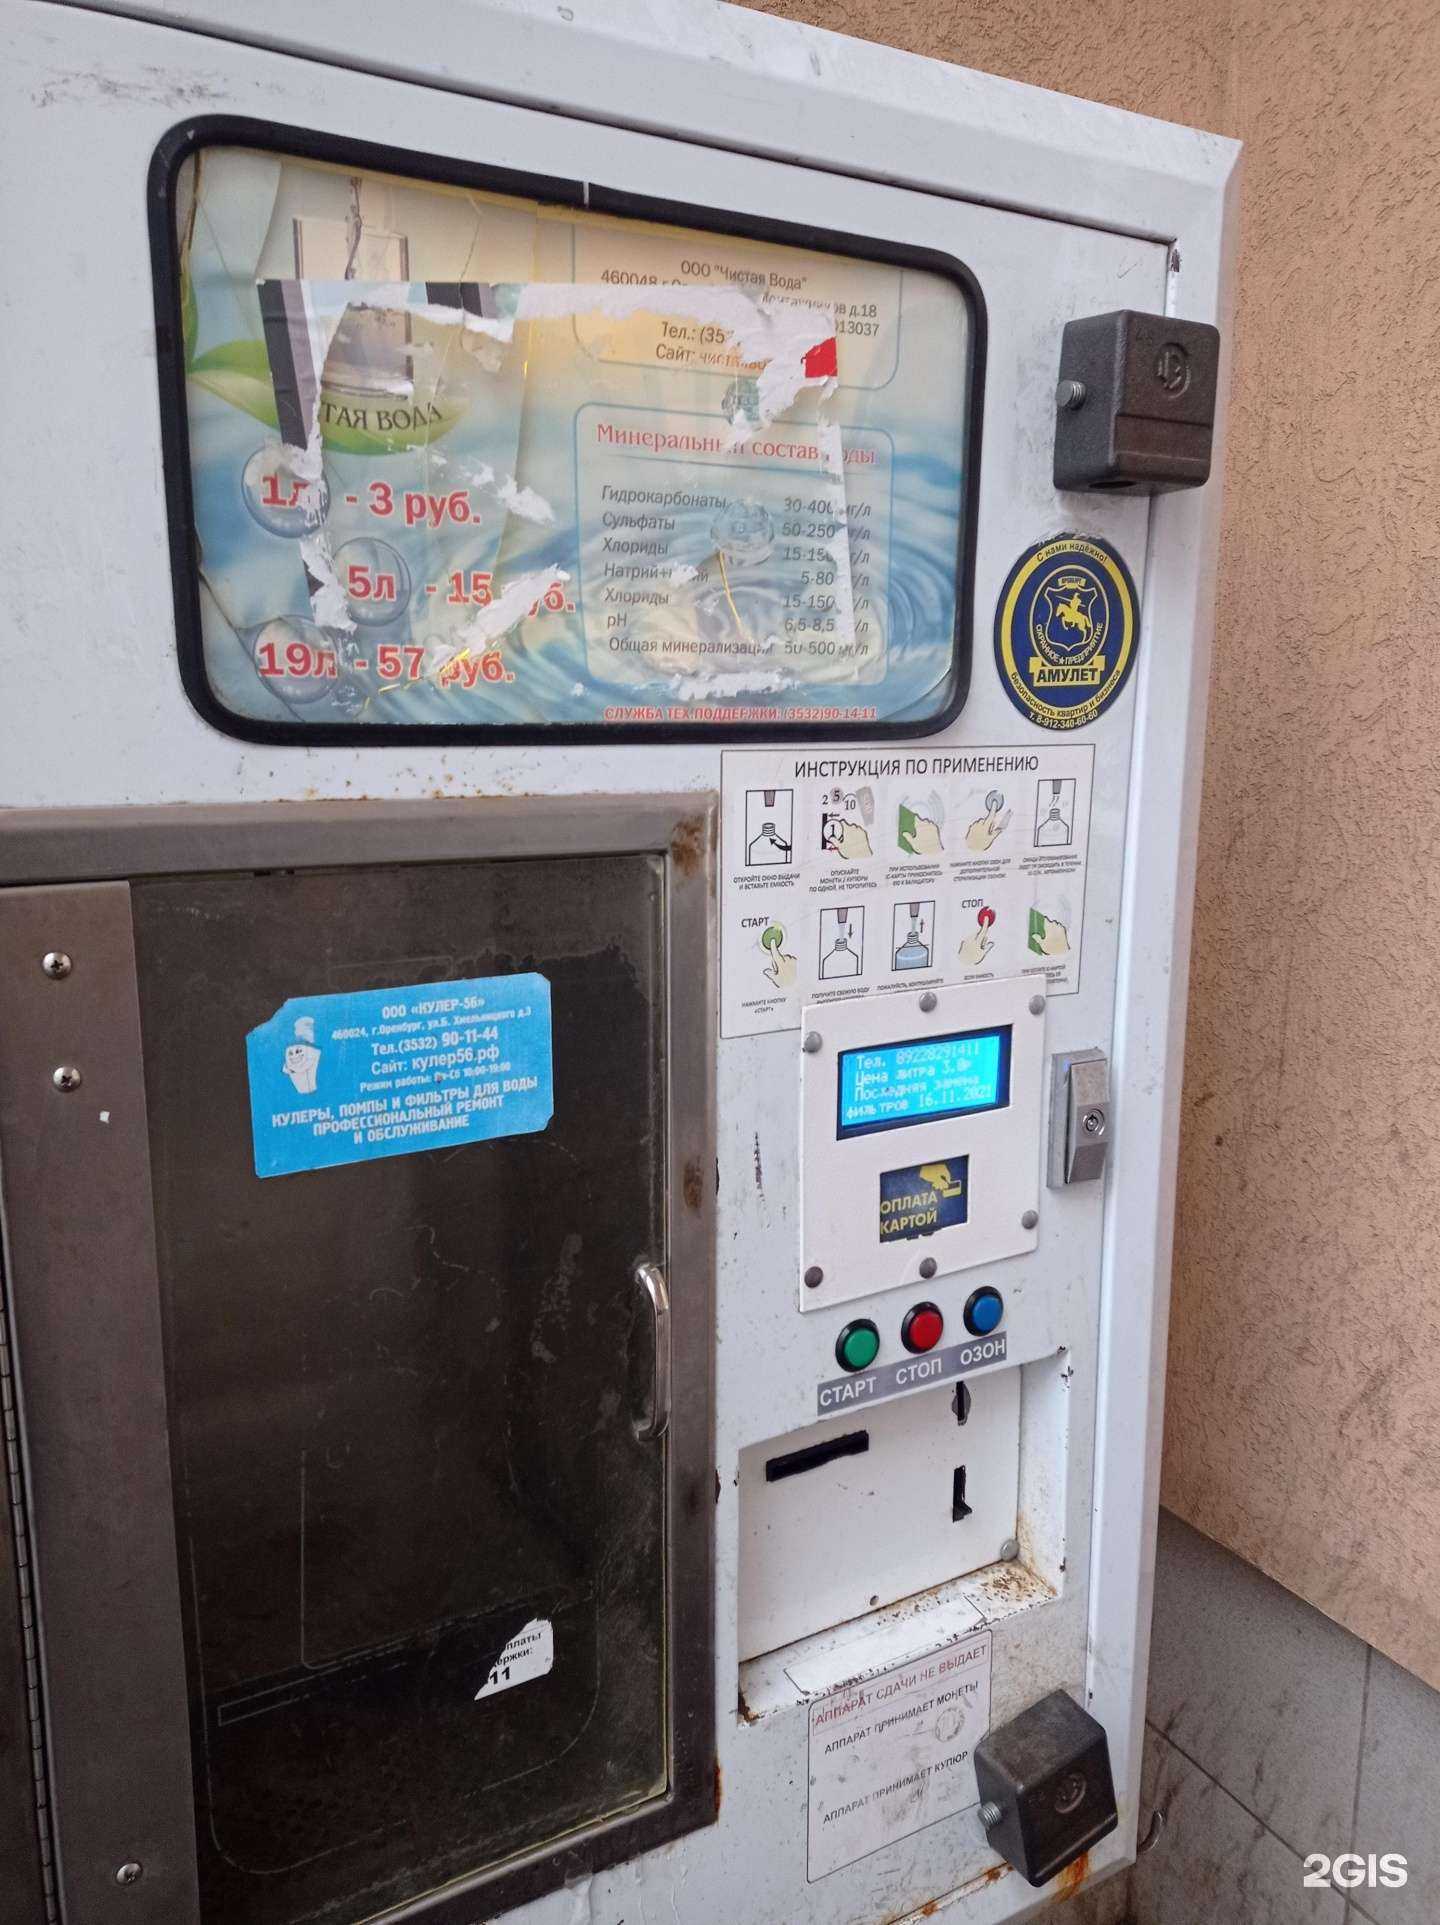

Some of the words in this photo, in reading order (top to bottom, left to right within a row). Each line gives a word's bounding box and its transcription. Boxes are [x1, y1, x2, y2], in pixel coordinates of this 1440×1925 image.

[680, 259, 711, 278] ООО
[714, 264, 766, 286] "Чистая
[768, 273, 807, 291] Вода"
[849, 304, 877, 319] д.18
[752, 440, 819, 460] состав
[368, 481, 393, 516] 3
[404, 490, 482, 528] руб.
[602, 511, 675, 532] Сульфаты
[781, 523, 836, 539] 50-250
[602, 536, 669, 556] Хлориды
[1045, 543, 1067, 557] нами
[347, 564, 396, 600] 5л
[448, 571, 494, 607] 15
[800, 571, 834, 586] 5-80
[603, 587, 670, 605] Хлориды
[784, 595, 836, 611] 15-150
[608, 636, 658, 654] Общая
[258, 642, 338, 678] 19л
[377, 645, 425, 680] 57
[1036, 667, 1099, 682] АМУЛЕТ
[604, 706, 664, 720] СЛУЖБА
[783, 706, 877, 721] (3532)90-14-11
[1057, 705, 1089, 719] квартир
[795, 759, 901, 779] ИНСТРУКЦИЯ
[905, 758, 928, 775] ПО
[935, 755, 1040, 774] ПРИМЕНЕНИЮ
[822, 794, 829, 805] 2
[833, 790, 840, 802] 5
[845, 799, 857, 811] 10
[961, 898, 984, 910] СТОП
[741, 916, 769, 929] СТАРТ
[381, 1003, 407, 1019] ООО
[441, 1026, 499, 1047] 90-11-44
[371, 1060, 408, 1076] Сайт:
[412, 1043, 501, 1072] кулер56.рф
[856, 1055, 887, 1070] Тел.
[855, 1070, 889, 1087] Цена
[272, 1108, 334, 1129] КУЛЕРЫ,
[339, 1100, 388, 1117] ПОМПЫ
[392, 1098, 400, 1109] И
[404, 1089, 470, 1109] ФИЛЬТРЫ
[473, 1084, 500, 1100] ДЛЯ
[502, 1076, 539, 1093] ВОДЫ
[313, 1101, 454, 1137] ПРОФЕССИОНАЛЬНЫЙ
[456, 1095, 505, 1113] РЕМОНТ
[353, 1131, 363, 1145] И
[367, 1114, 470, 1143] ОБСЛУЖИВАНИЕ
[880, 1191, 938, 1214] ОПЛАТА
[880, 1208, 938, 1234] КАРТОЙ
[820, 1377, 877, 1407] СТАРТ
[896, 1358, 943, 1385] СТОП
[960, 1339, 1006, 1365] ОЗОН
[815, 1694, 872, 1726] АППАРАТ
[875, 1675, 917, 1700] СДАЧИ
[919, 1666, 936, 1681] НЕ
[938, 1645, 987, 1674] ВЫДАЕТ
[824, 1727, 871, 1755] АППАРАТ
[874, 1701, 935, 1734] ПРИНИМАЕТ
[936, 1680, 979, 1705] МОНЕТЫ
[823, 1796, 869, 1824] АППАРАТ
[872, 1767, 932, 1801] ПРИНИМАЕТ
[934, 1750, 969, 1775] КУПЮР
